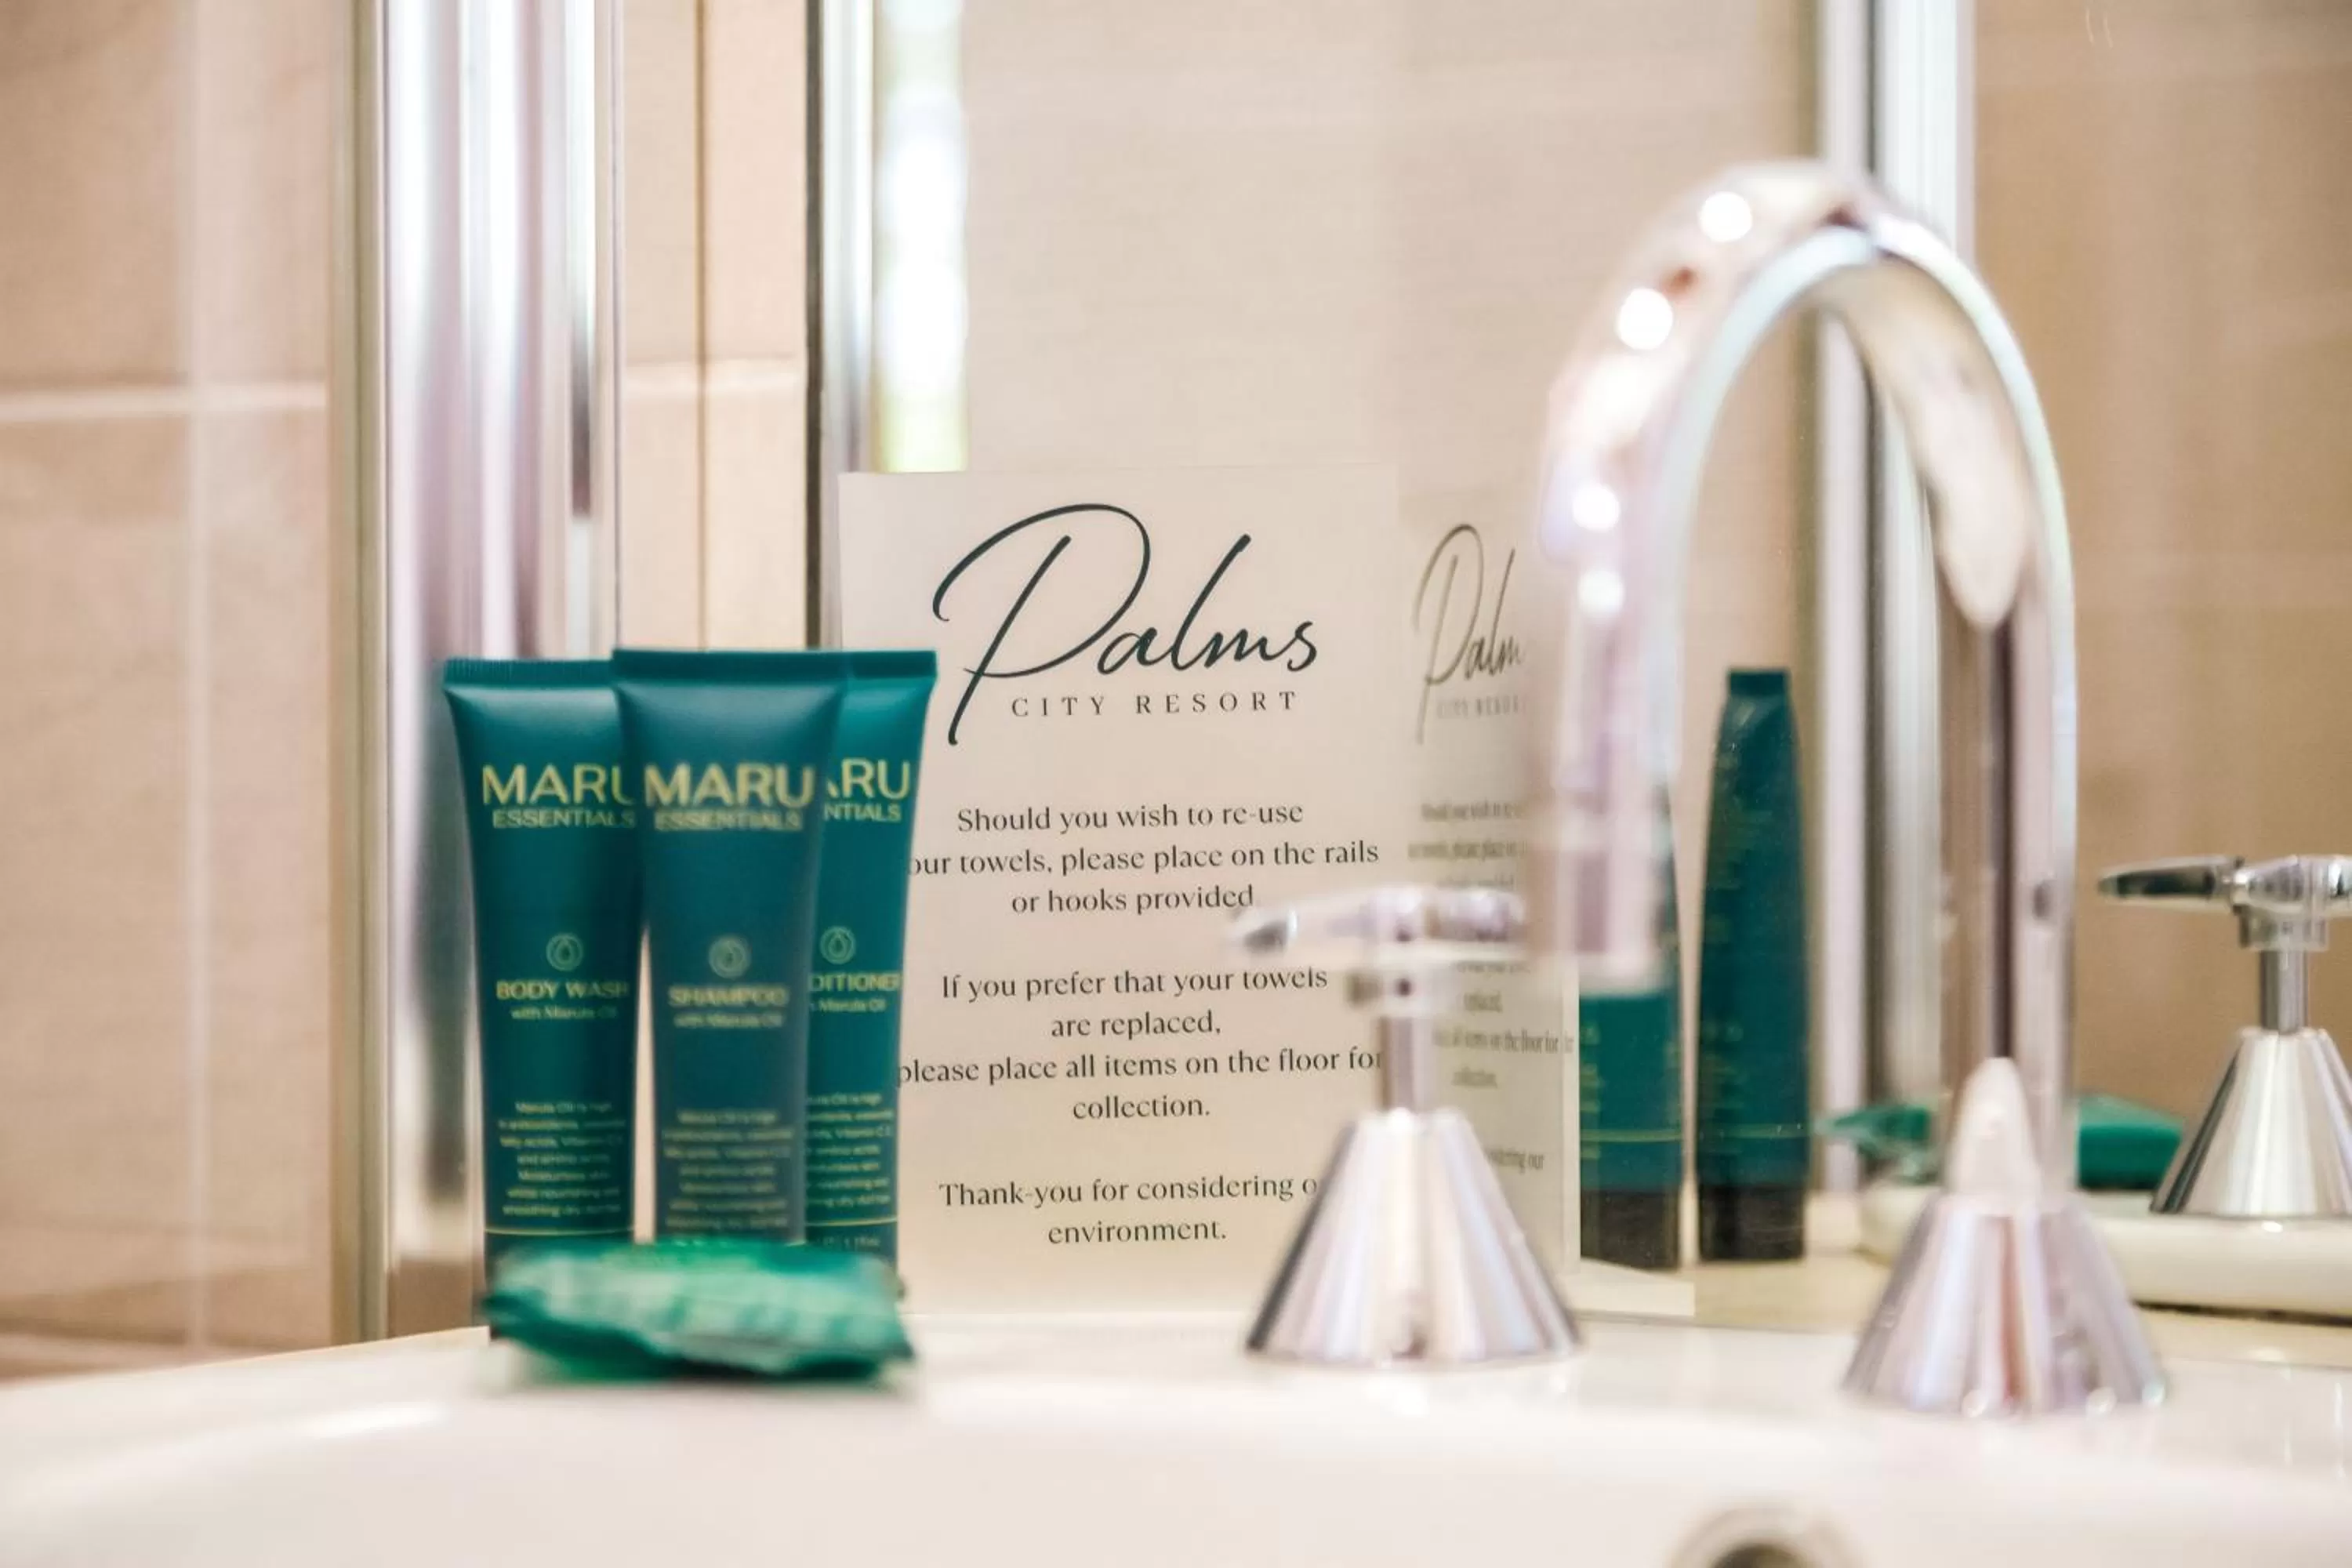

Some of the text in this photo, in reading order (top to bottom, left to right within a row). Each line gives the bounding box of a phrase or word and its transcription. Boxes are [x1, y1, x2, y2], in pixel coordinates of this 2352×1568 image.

[932, 503, 1318, 747] Palms
[1011, 690, 1296, 717] CITY RESORT
[644, 762, 815, 808] MARU
[492, 808, 635, 829] ESSENTIALS
[654, 810, 804, 832] ESSENTIALS
[823, 802, 902, 822] NTIALS
[957, 802, 1303, 836] Should you wish to re-use
[913, 855, 952, 876] our
[960, 848, 1053, 876] towels,
[1061, 846, 1145, 877] please
[1153, 844, 1223, 875] place
[1230, 848, 1265, 866] on
[1272, 840, 1317, 866] the
[1324, 839, 1380, 864] rails
[1011, 883, 1254, 915] or hooks provided
[495, 980, 630, 1000] BODY WASH
[668, 985, 789, 1007] SHAMPOO
[942, 965, 1328, 1004] If you prefer that your towels
[1051, 1007, 1221, 1041] are replaced,
[896, 1045, 1382, 1089] please place all items on the floor for
[1072, 1094, 1210, 1120] collection.
[938, 1180, 1083, 1210] Thank-you
[1091, 1178, 1130, 1203] for
[1136, 1174, 1294, 1203] considering
[1047, 1219, 1227, 1245] environment.
